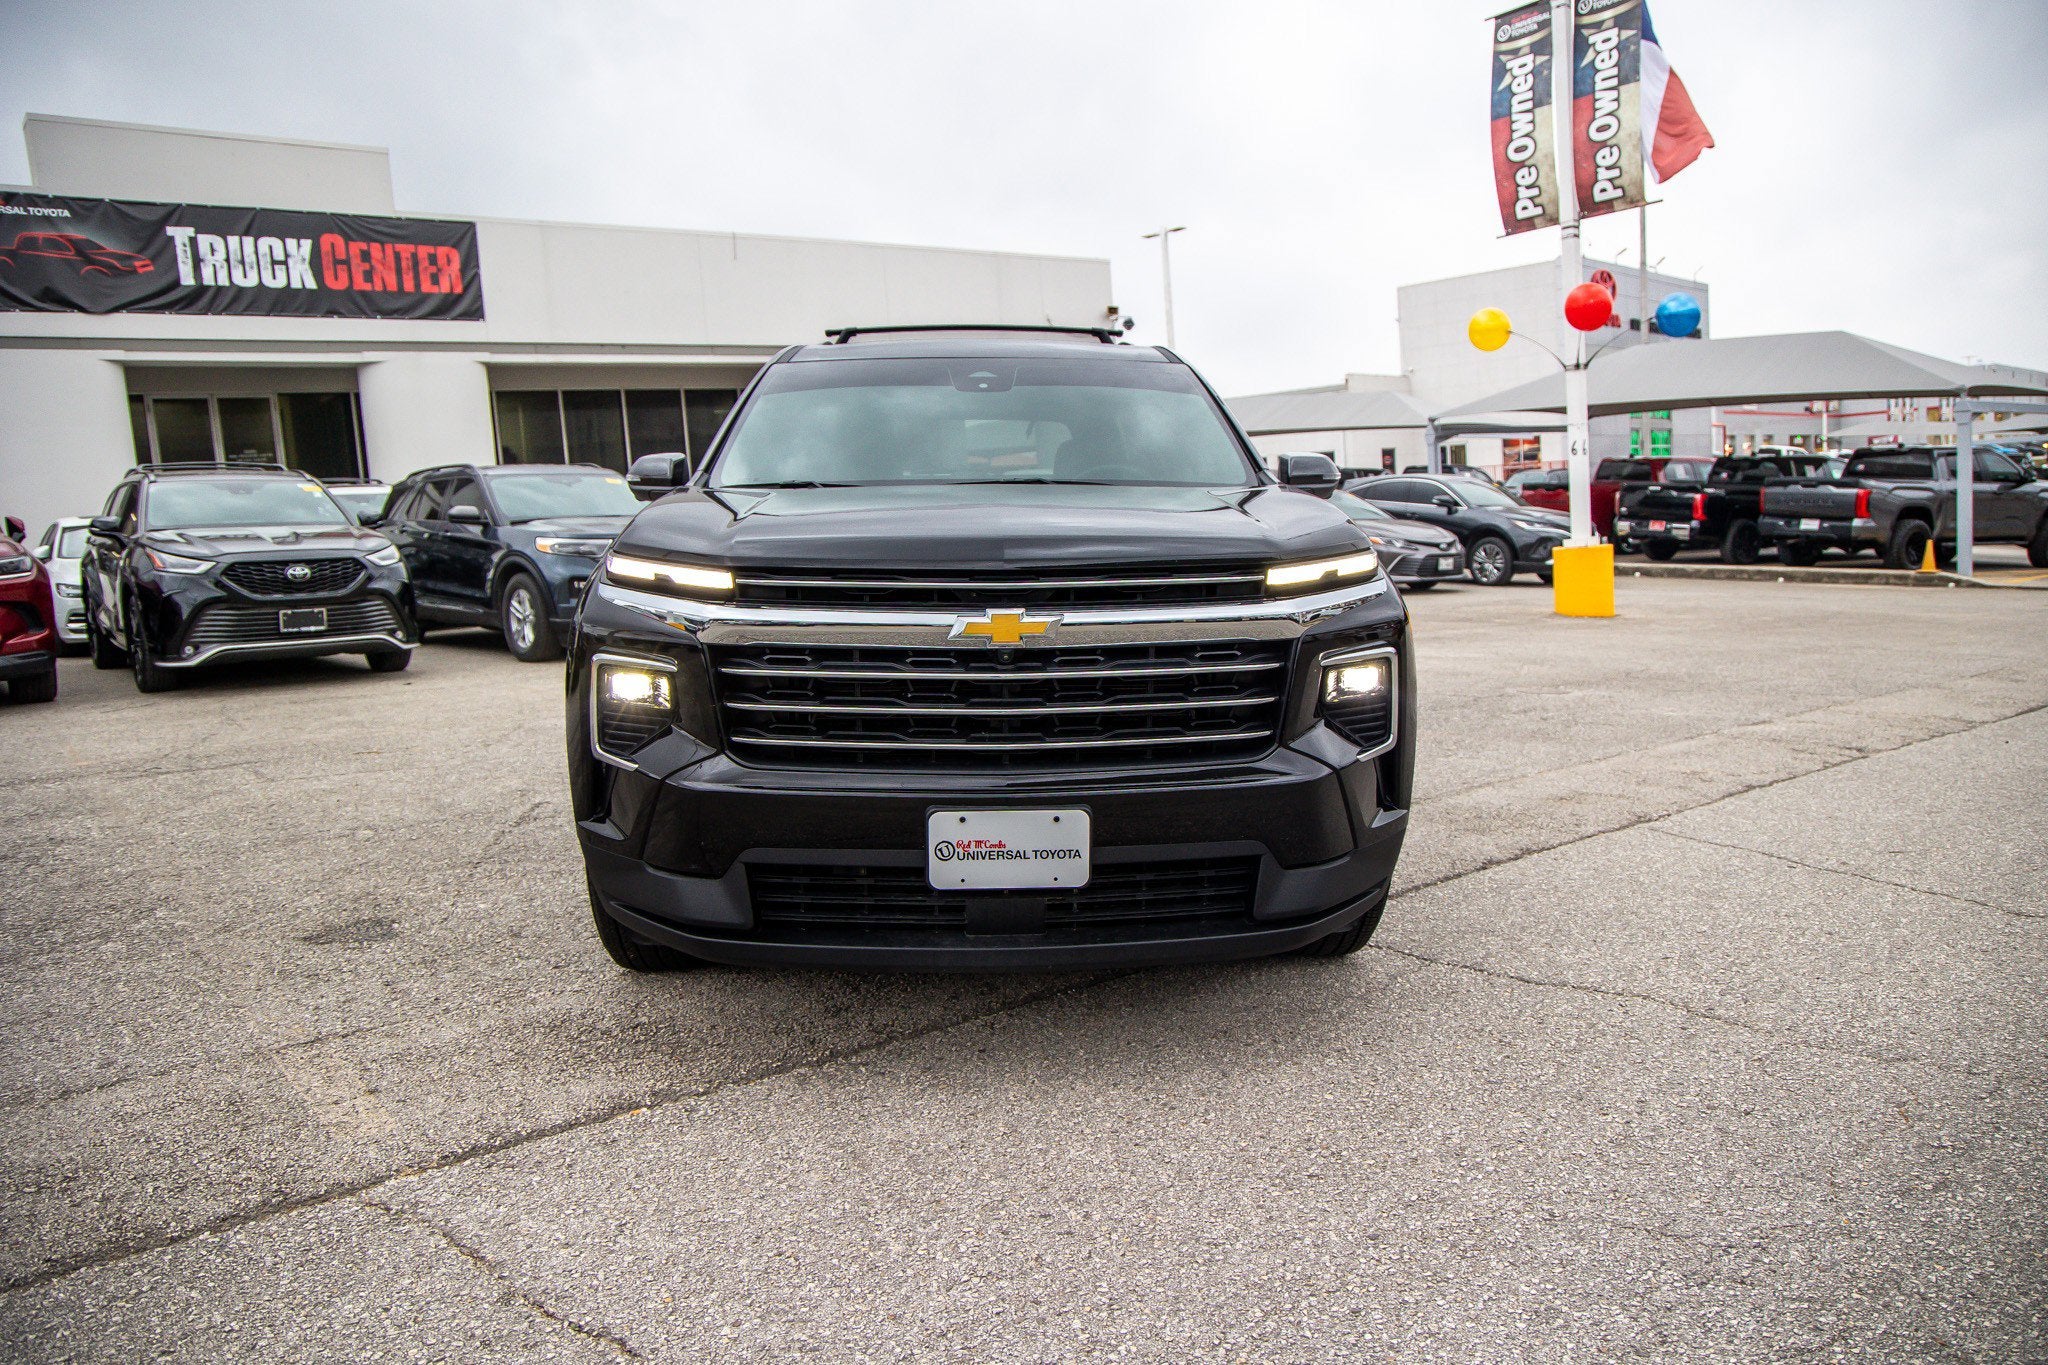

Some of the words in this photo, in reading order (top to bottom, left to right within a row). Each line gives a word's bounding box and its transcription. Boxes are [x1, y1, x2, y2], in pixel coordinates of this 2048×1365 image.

[1592, 0, 1620, 10] TOYO
[1506, 53, 1536, 162] Owned
[1588, 27, 1620, 142] Owned
[1514, 165, 1544, 221] Pre
[1592, 145, 1624, 203] Pre
[27, 206, 71, 218] TOYOTA
[166, 226, 318, 289] TRUCK
[320, 233, 464, 294] CENTER
[956, 850, 1030, 861] UNIVERSAL
[1032, 849, 1082, 859] TOYOTA
[957, 840, 972, 852] Red
